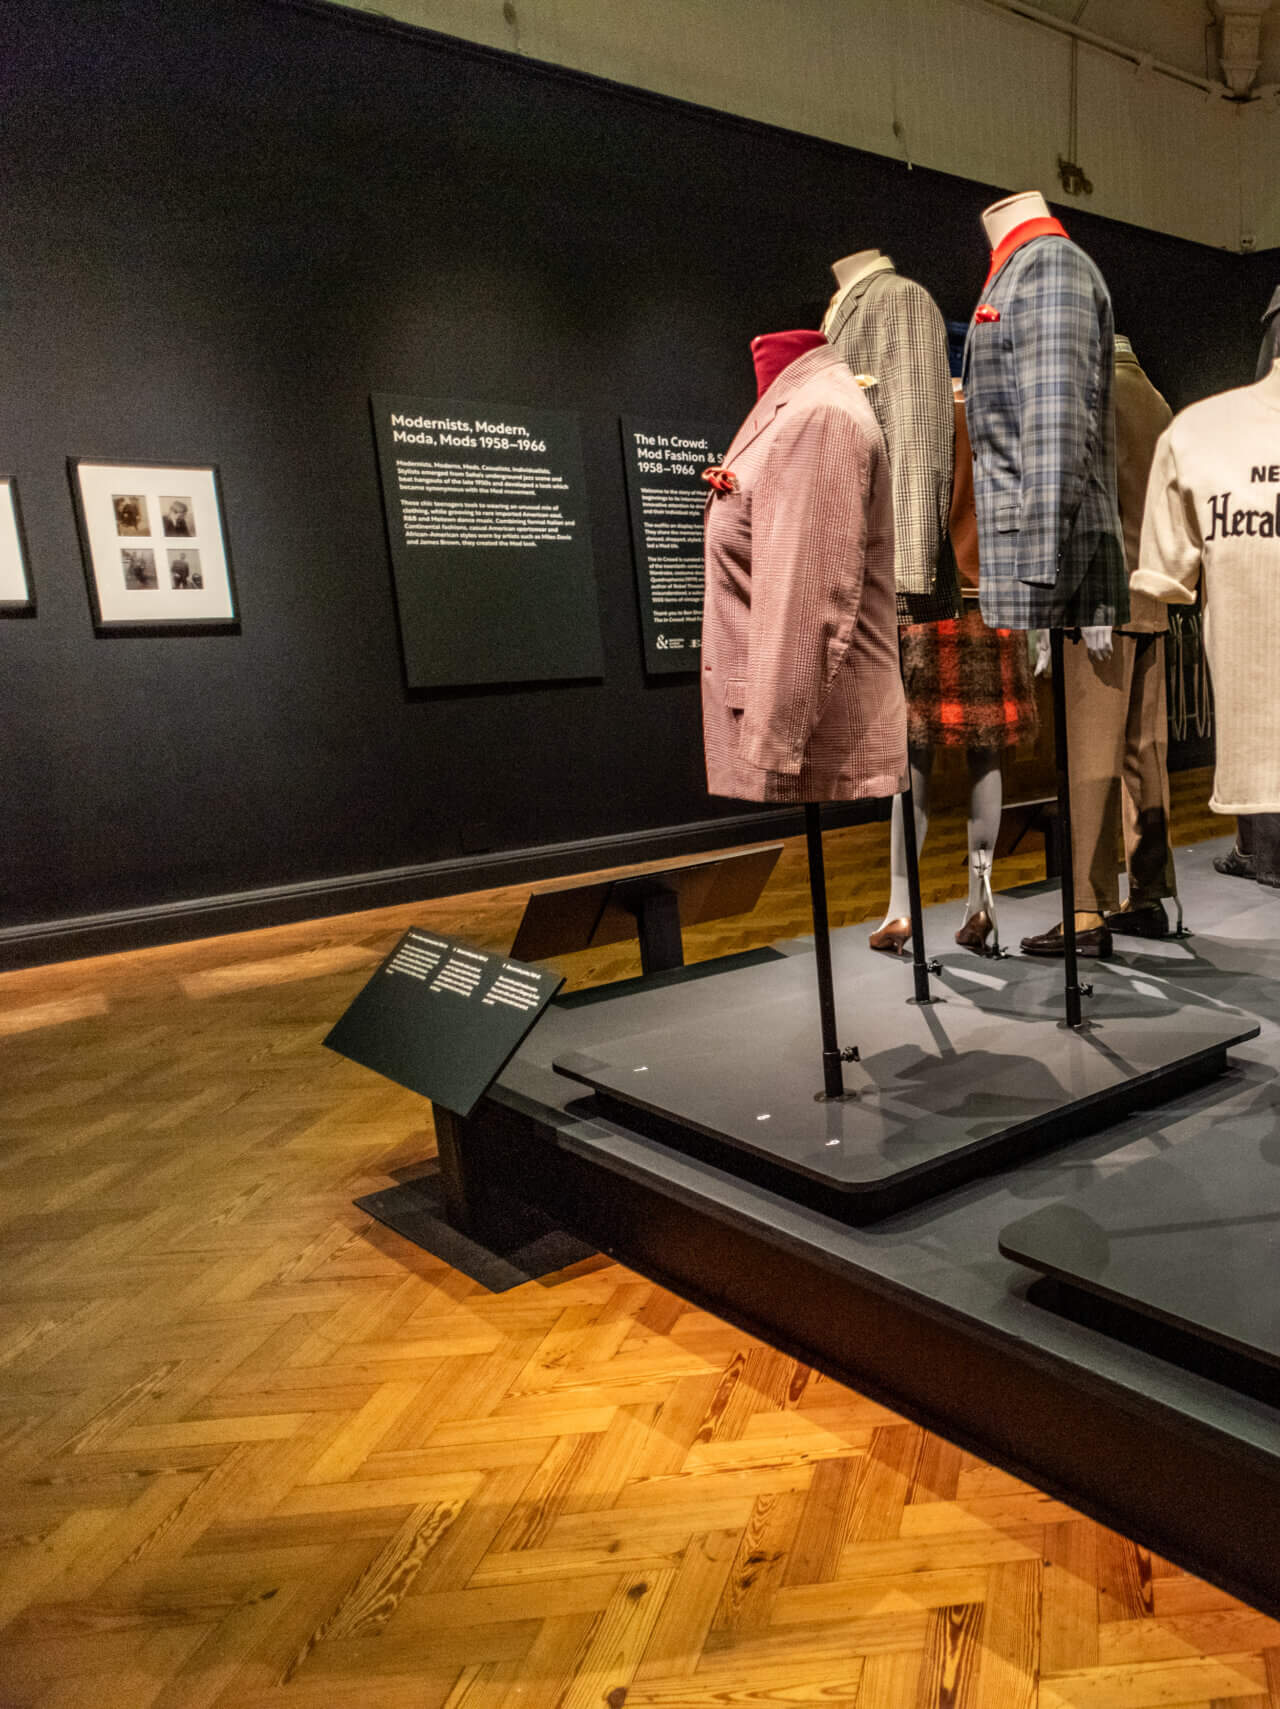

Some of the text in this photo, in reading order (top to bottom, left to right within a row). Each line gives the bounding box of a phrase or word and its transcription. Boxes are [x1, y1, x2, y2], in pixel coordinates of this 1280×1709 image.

[391, 414, 530, 437] Modernists, Modern,
[393, 430, 437, 446] Moda,
[440, 434, 477, 447] Mods
[633, 433, 708, 449] The In Crowd:
[637, 448, 662, 460] Mod
[664, 450, 705, 462] Fashion
[707, 453, 716, 463] &
